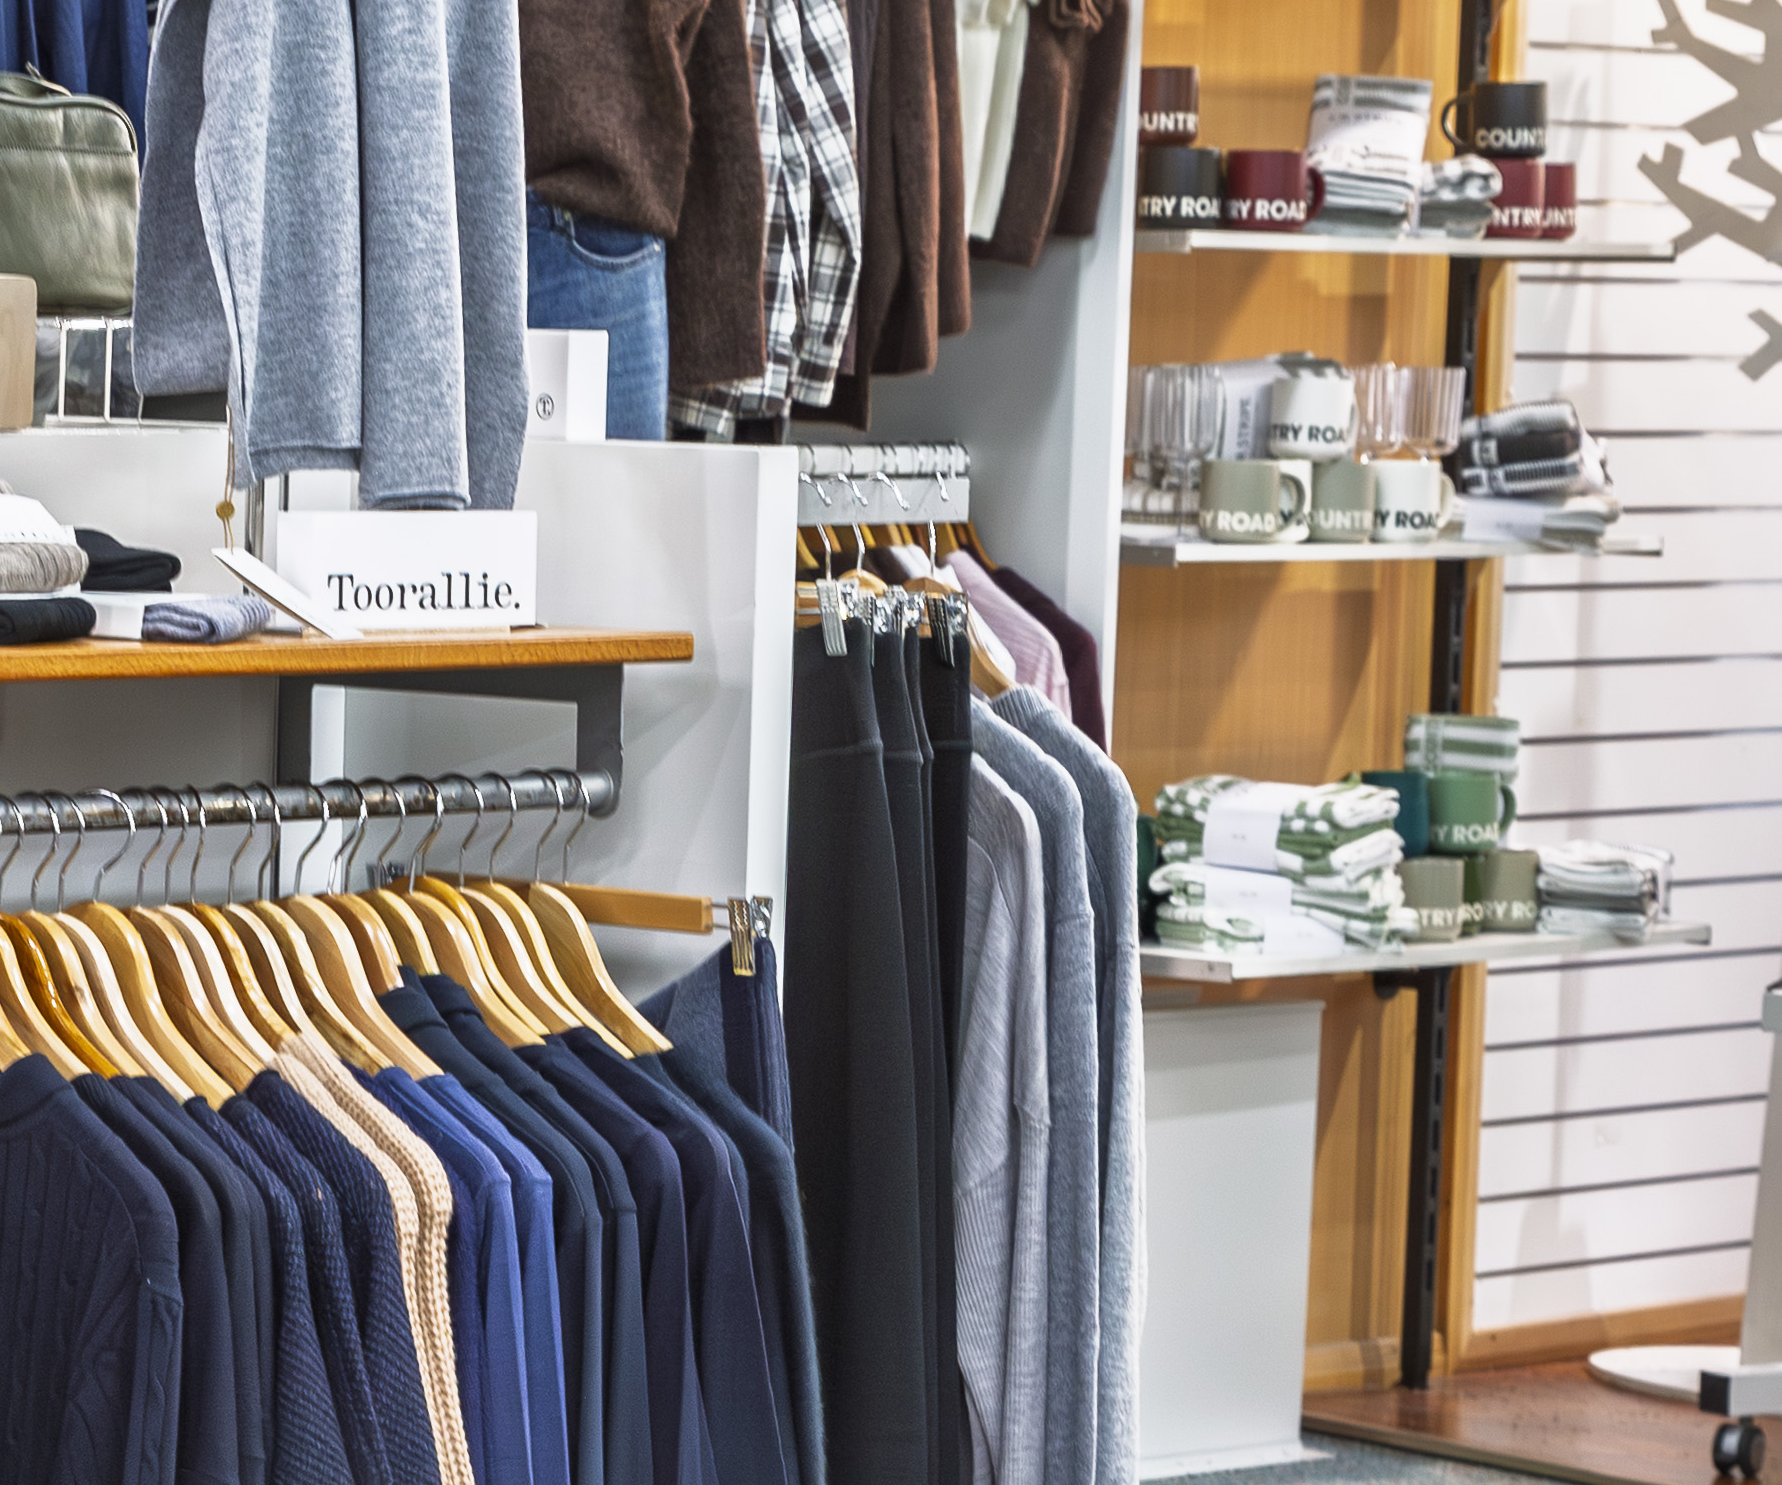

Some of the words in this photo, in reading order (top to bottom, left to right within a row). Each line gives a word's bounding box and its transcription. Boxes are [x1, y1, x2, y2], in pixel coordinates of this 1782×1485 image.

[1180, 196, 1222, 219] ROA
[1308, 424, 1346, 445] ROA
[1395, 507, 1441, 530] ROA
[327, 571, 520, 611] Toorallie.
